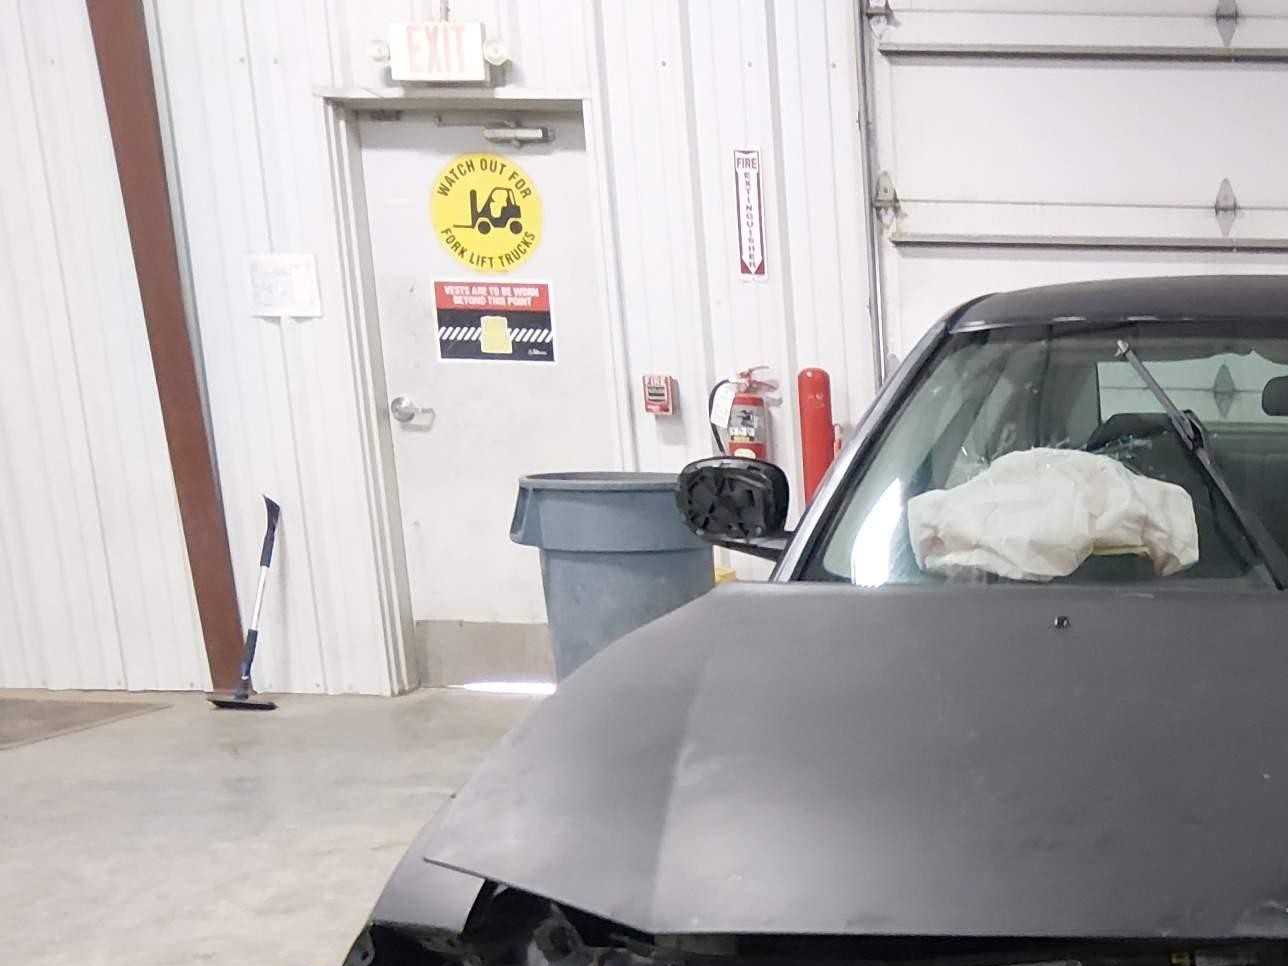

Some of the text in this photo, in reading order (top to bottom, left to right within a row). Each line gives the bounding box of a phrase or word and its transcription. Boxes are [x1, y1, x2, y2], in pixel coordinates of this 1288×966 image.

[406, 24, 465, 73] EXIT
[437, 158, 532, 199] WATCH OUT FOR
[736, 157, 757, 169] FIRE
[743, 171, 756, 268] EXTINGUISHER
[440, 228, 536, 268] FORK LIFT TRUCKS
[444, 285, 470, 295] VESTS
[471, 286, 487, 296] ARE
[488, 287, 499, 296] TO
[507, 296, 532, 306] POINT
